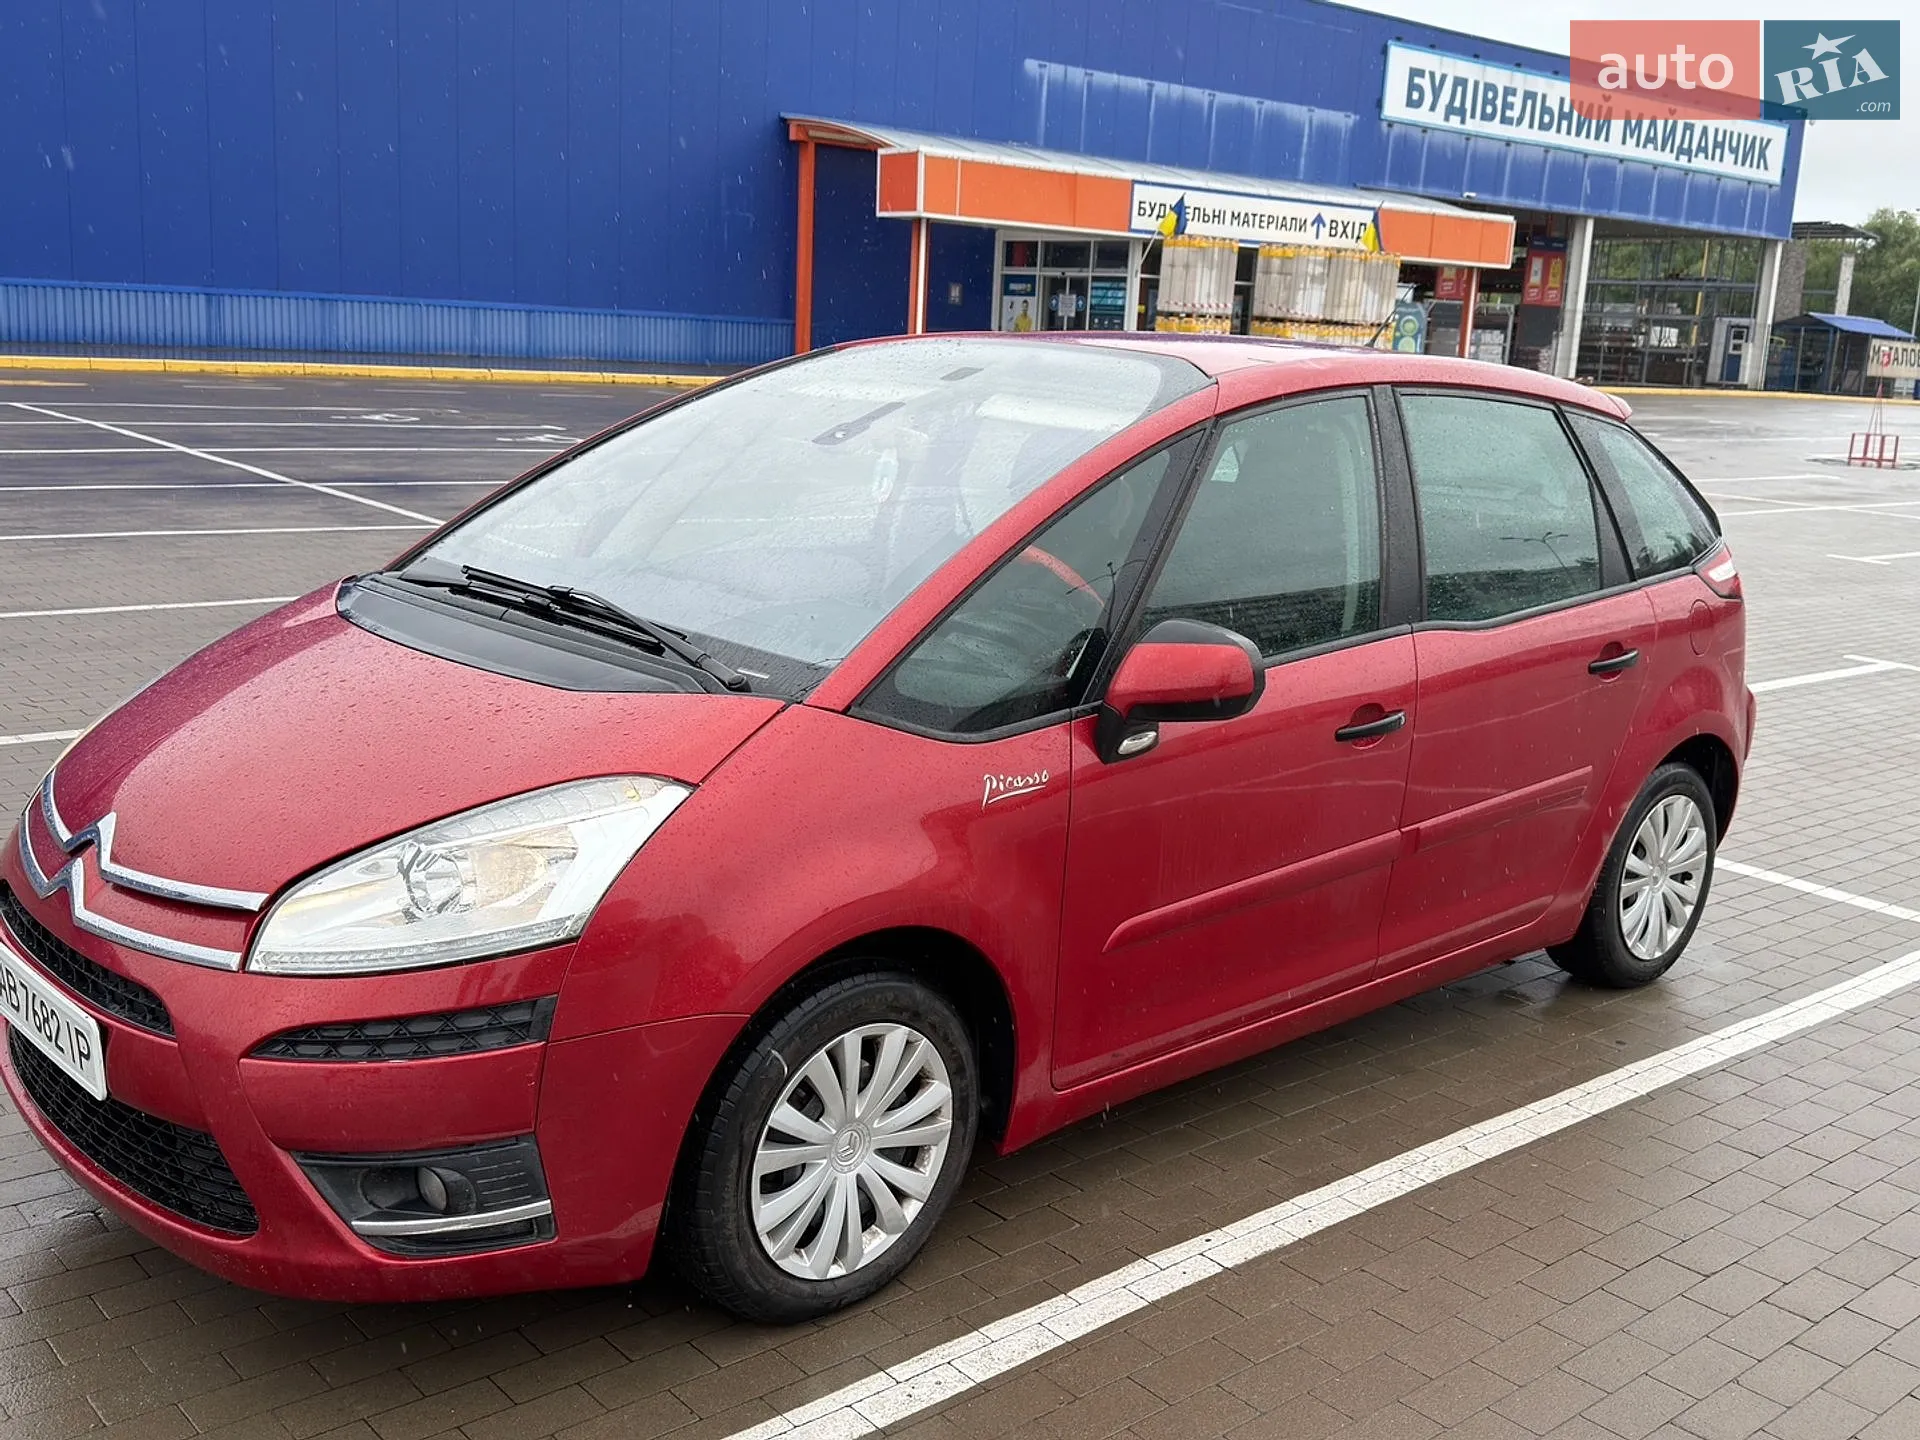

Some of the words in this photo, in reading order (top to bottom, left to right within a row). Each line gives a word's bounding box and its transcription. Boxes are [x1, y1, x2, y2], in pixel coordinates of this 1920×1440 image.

[1405, 66, 1614, 143] БУДІВЕЛЬНИЙ
[1621, 107, 1773, 171] МАЙДАНЧИК
[1137, 200, 1227, 225] БУДЕЛЬНІ
[1230, 211, 1308, 233] МАТЕРІАЛИ
[1871, 344, 1920, 368] МАЛО
[982, 769, 1049, 812] Picasso
